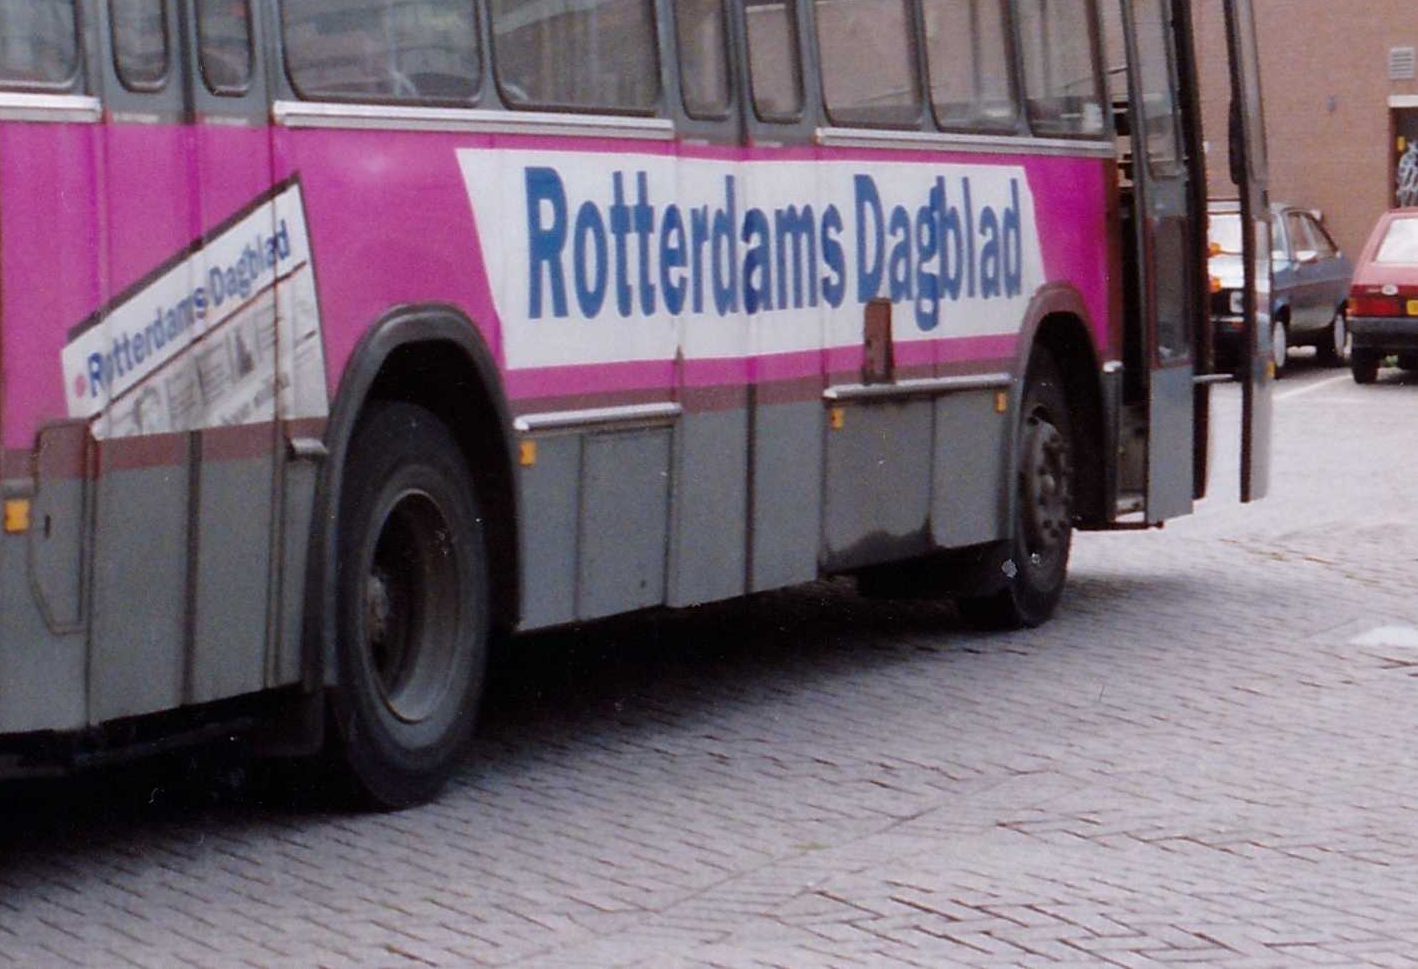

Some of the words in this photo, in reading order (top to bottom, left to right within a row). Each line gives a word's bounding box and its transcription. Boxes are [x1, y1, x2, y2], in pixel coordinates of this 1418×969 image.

[87, 287, 209, 399] Rotterdams
[209, 218, 291, 308] Dagblad
[524, 165, 846, 320] Rotterdams
[853, 173, 1024, 332] Dagblad
